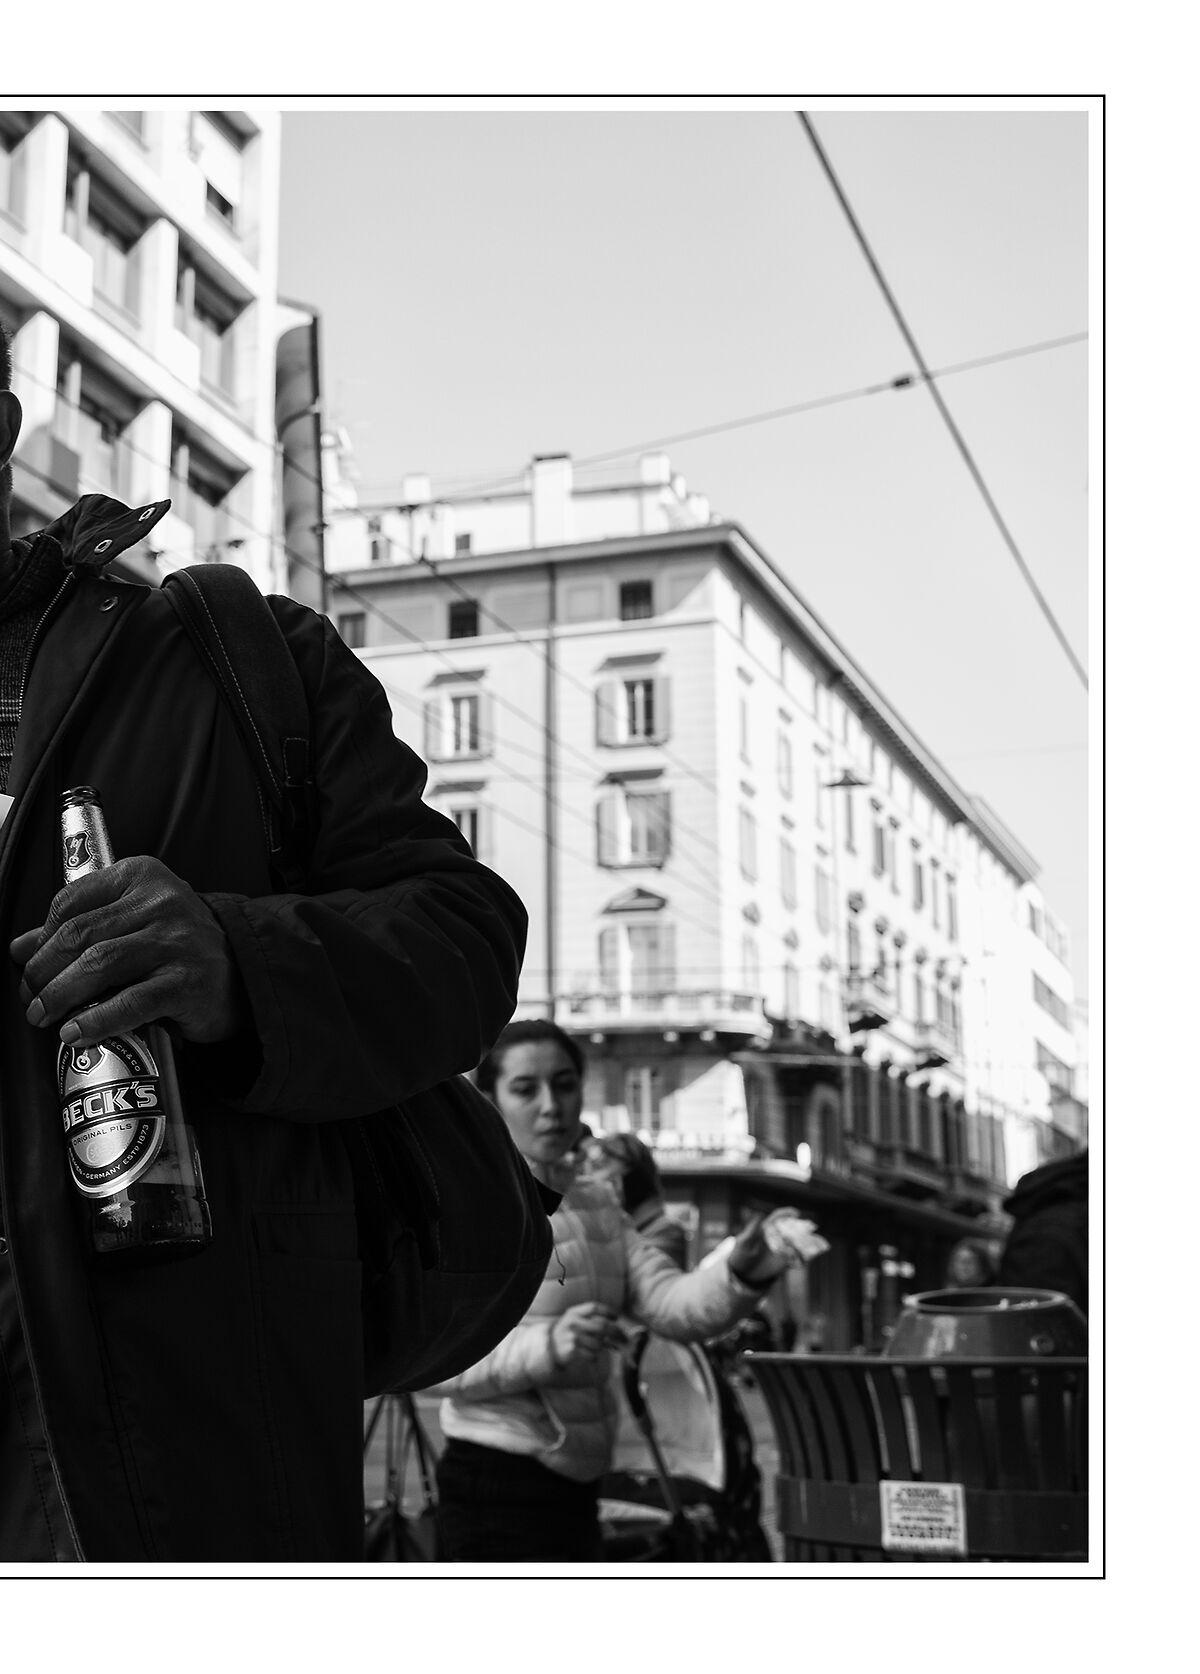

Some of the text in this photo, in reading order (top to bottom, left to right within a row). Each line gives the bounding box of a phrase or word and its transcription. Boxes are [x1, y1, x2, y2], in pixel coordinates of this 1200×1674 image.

[62, 1081, 158, 1132] BECK'S
[73, 1123, 133, 1146] ORIGINAL PILS
[137, 1123, 150, 1145] 1873
